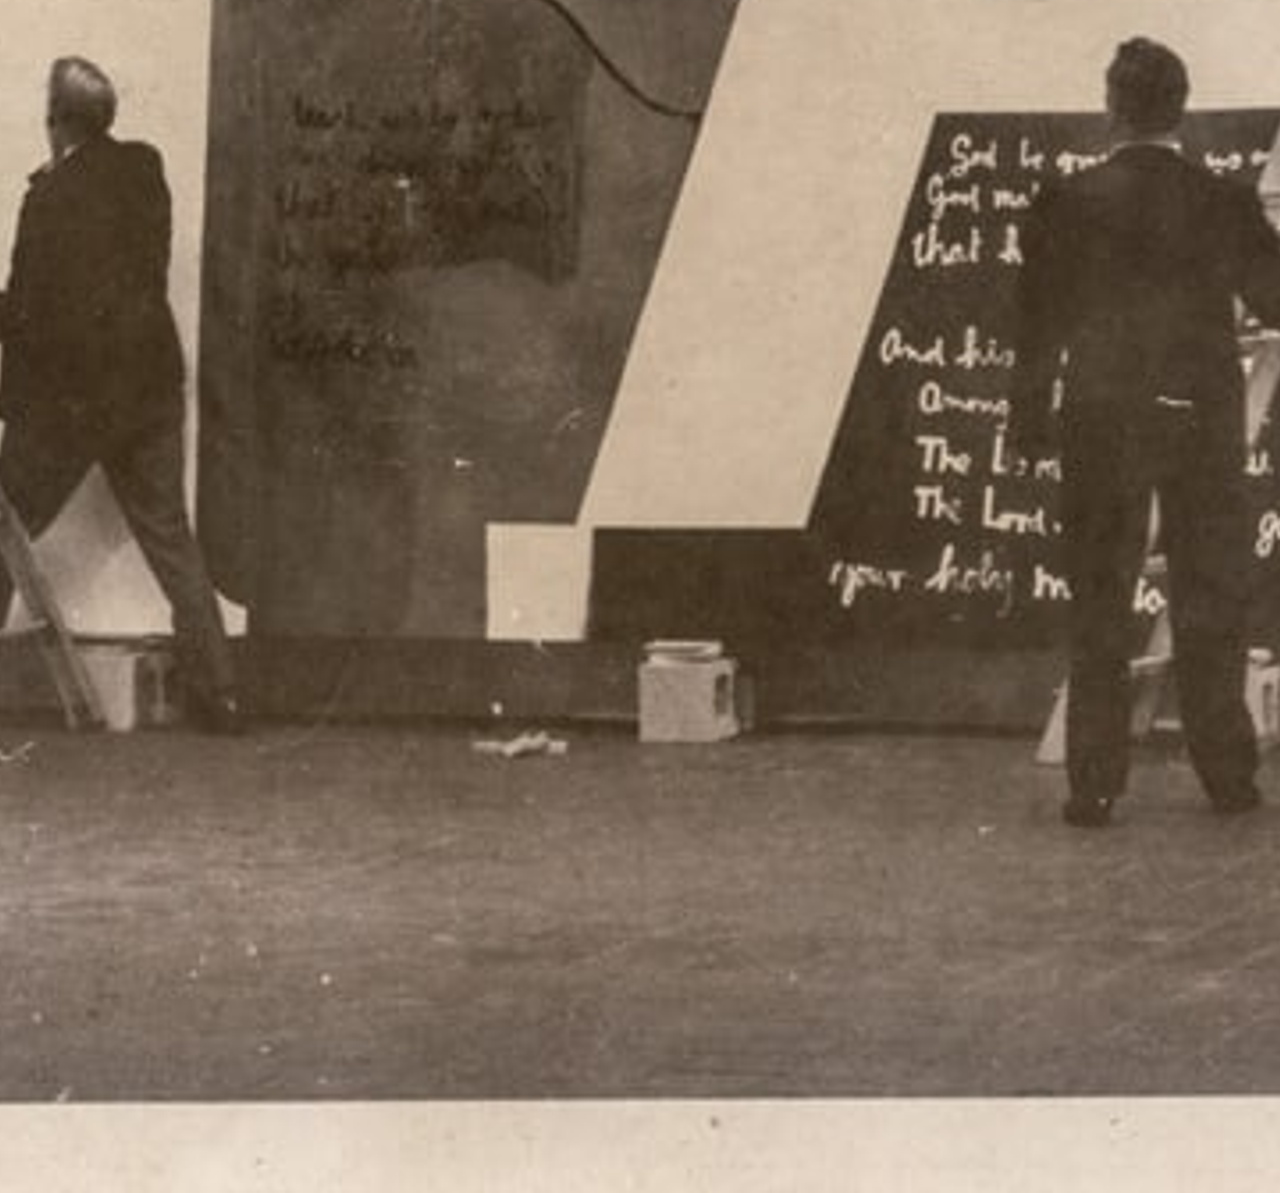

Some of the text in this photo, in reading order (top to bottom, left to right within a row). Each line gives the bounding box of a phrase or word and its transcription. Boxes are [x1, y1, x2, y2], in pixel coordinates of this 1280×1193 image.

[910, 219, 982, 269] that
[879, 325, 947, 367] And
[918, 379, 1011, 432] Among
[914, 435, 973, 476] The
